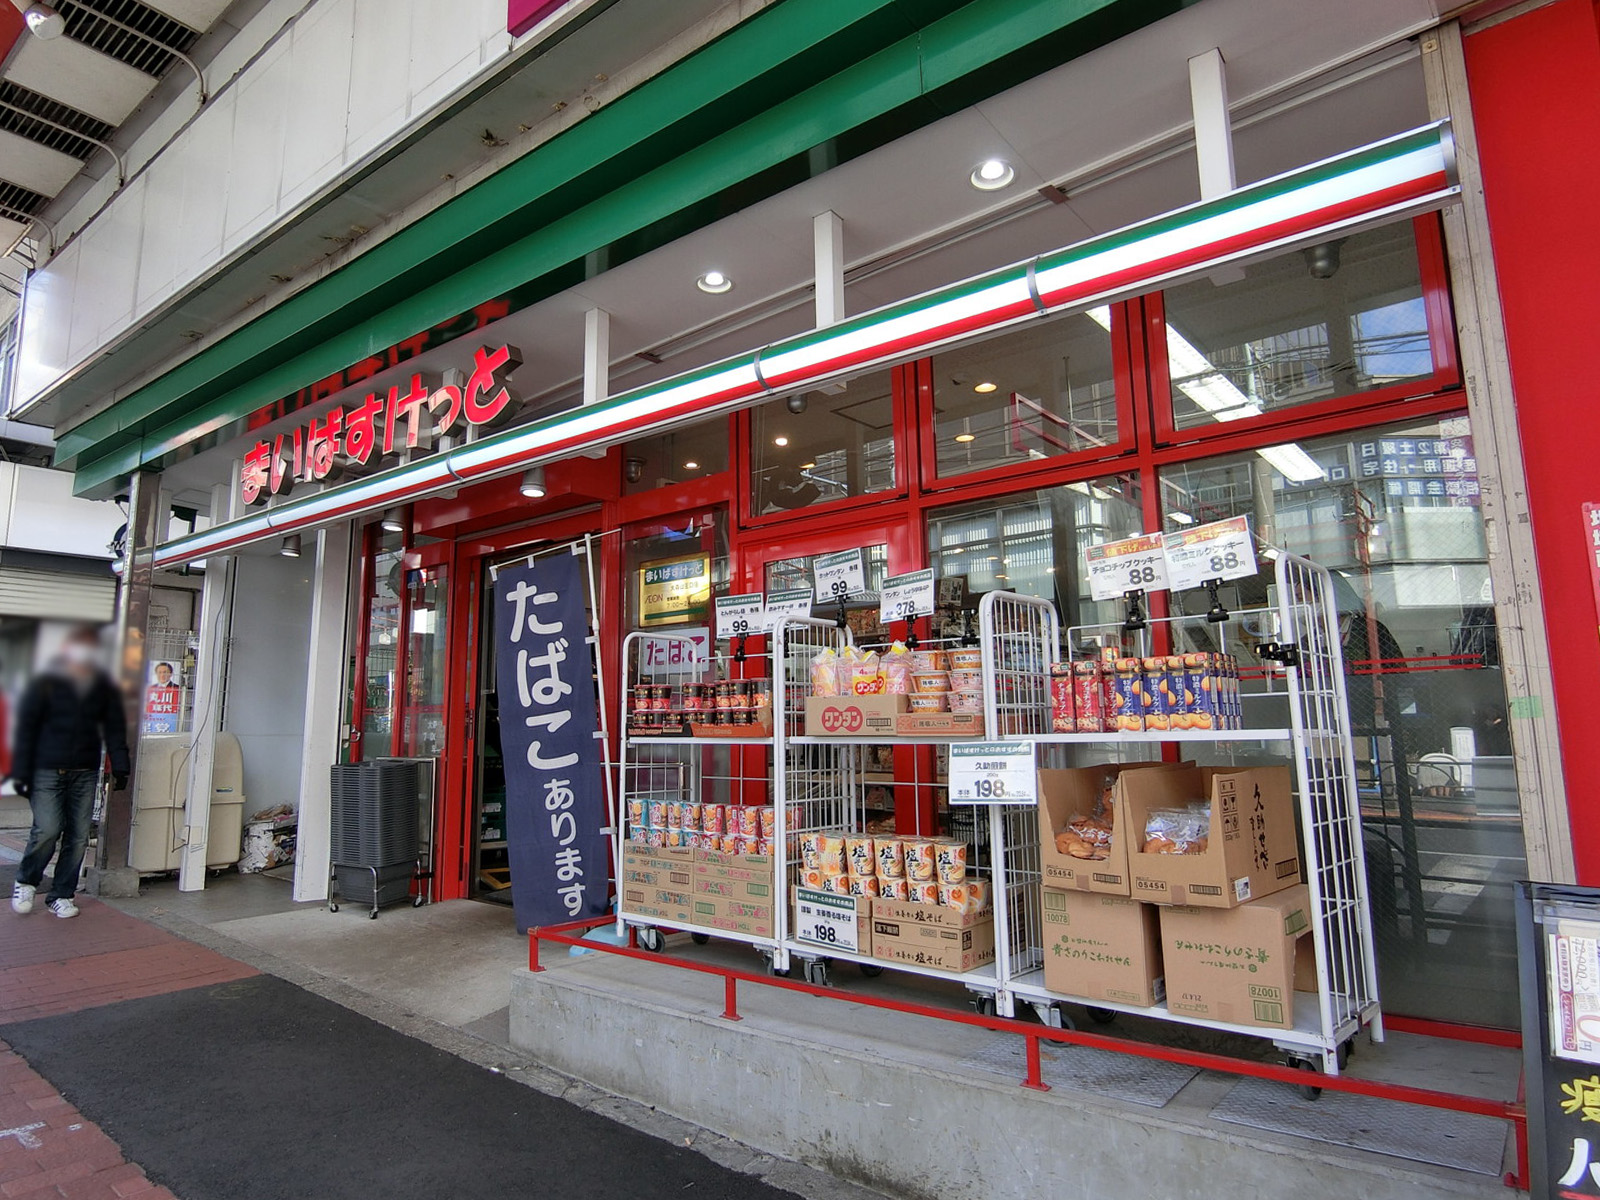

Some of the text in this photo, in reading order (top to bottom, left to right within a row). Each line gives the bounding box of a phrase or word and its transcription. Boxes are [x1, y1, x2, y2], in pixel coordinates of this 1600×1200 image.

[241, 344, 511, 505] まいばすけっと
[1092, 556, 1162, 574] チョコチップクッキー
[1210, 552, 1239, 572] 88
[645, 563, 703, 583] まいばすけっと
[1129, 566, 1155, 585] 88
[831, 580, 847, 595] 99
[896, 600, 915, 616] 378
[732, 620, 748, 632] 99
[824, 711, 861, 728] ワンタン
[974, 779, 1005, 797] 198
[1048, 868, 1071, 877] 05454
[1138, 881, 1165, 890] 05454
[1047, 914, 1068, 923] 10078
[814, 924, 836, 942] 198
[1251, 987, 1278, 998] 10078
